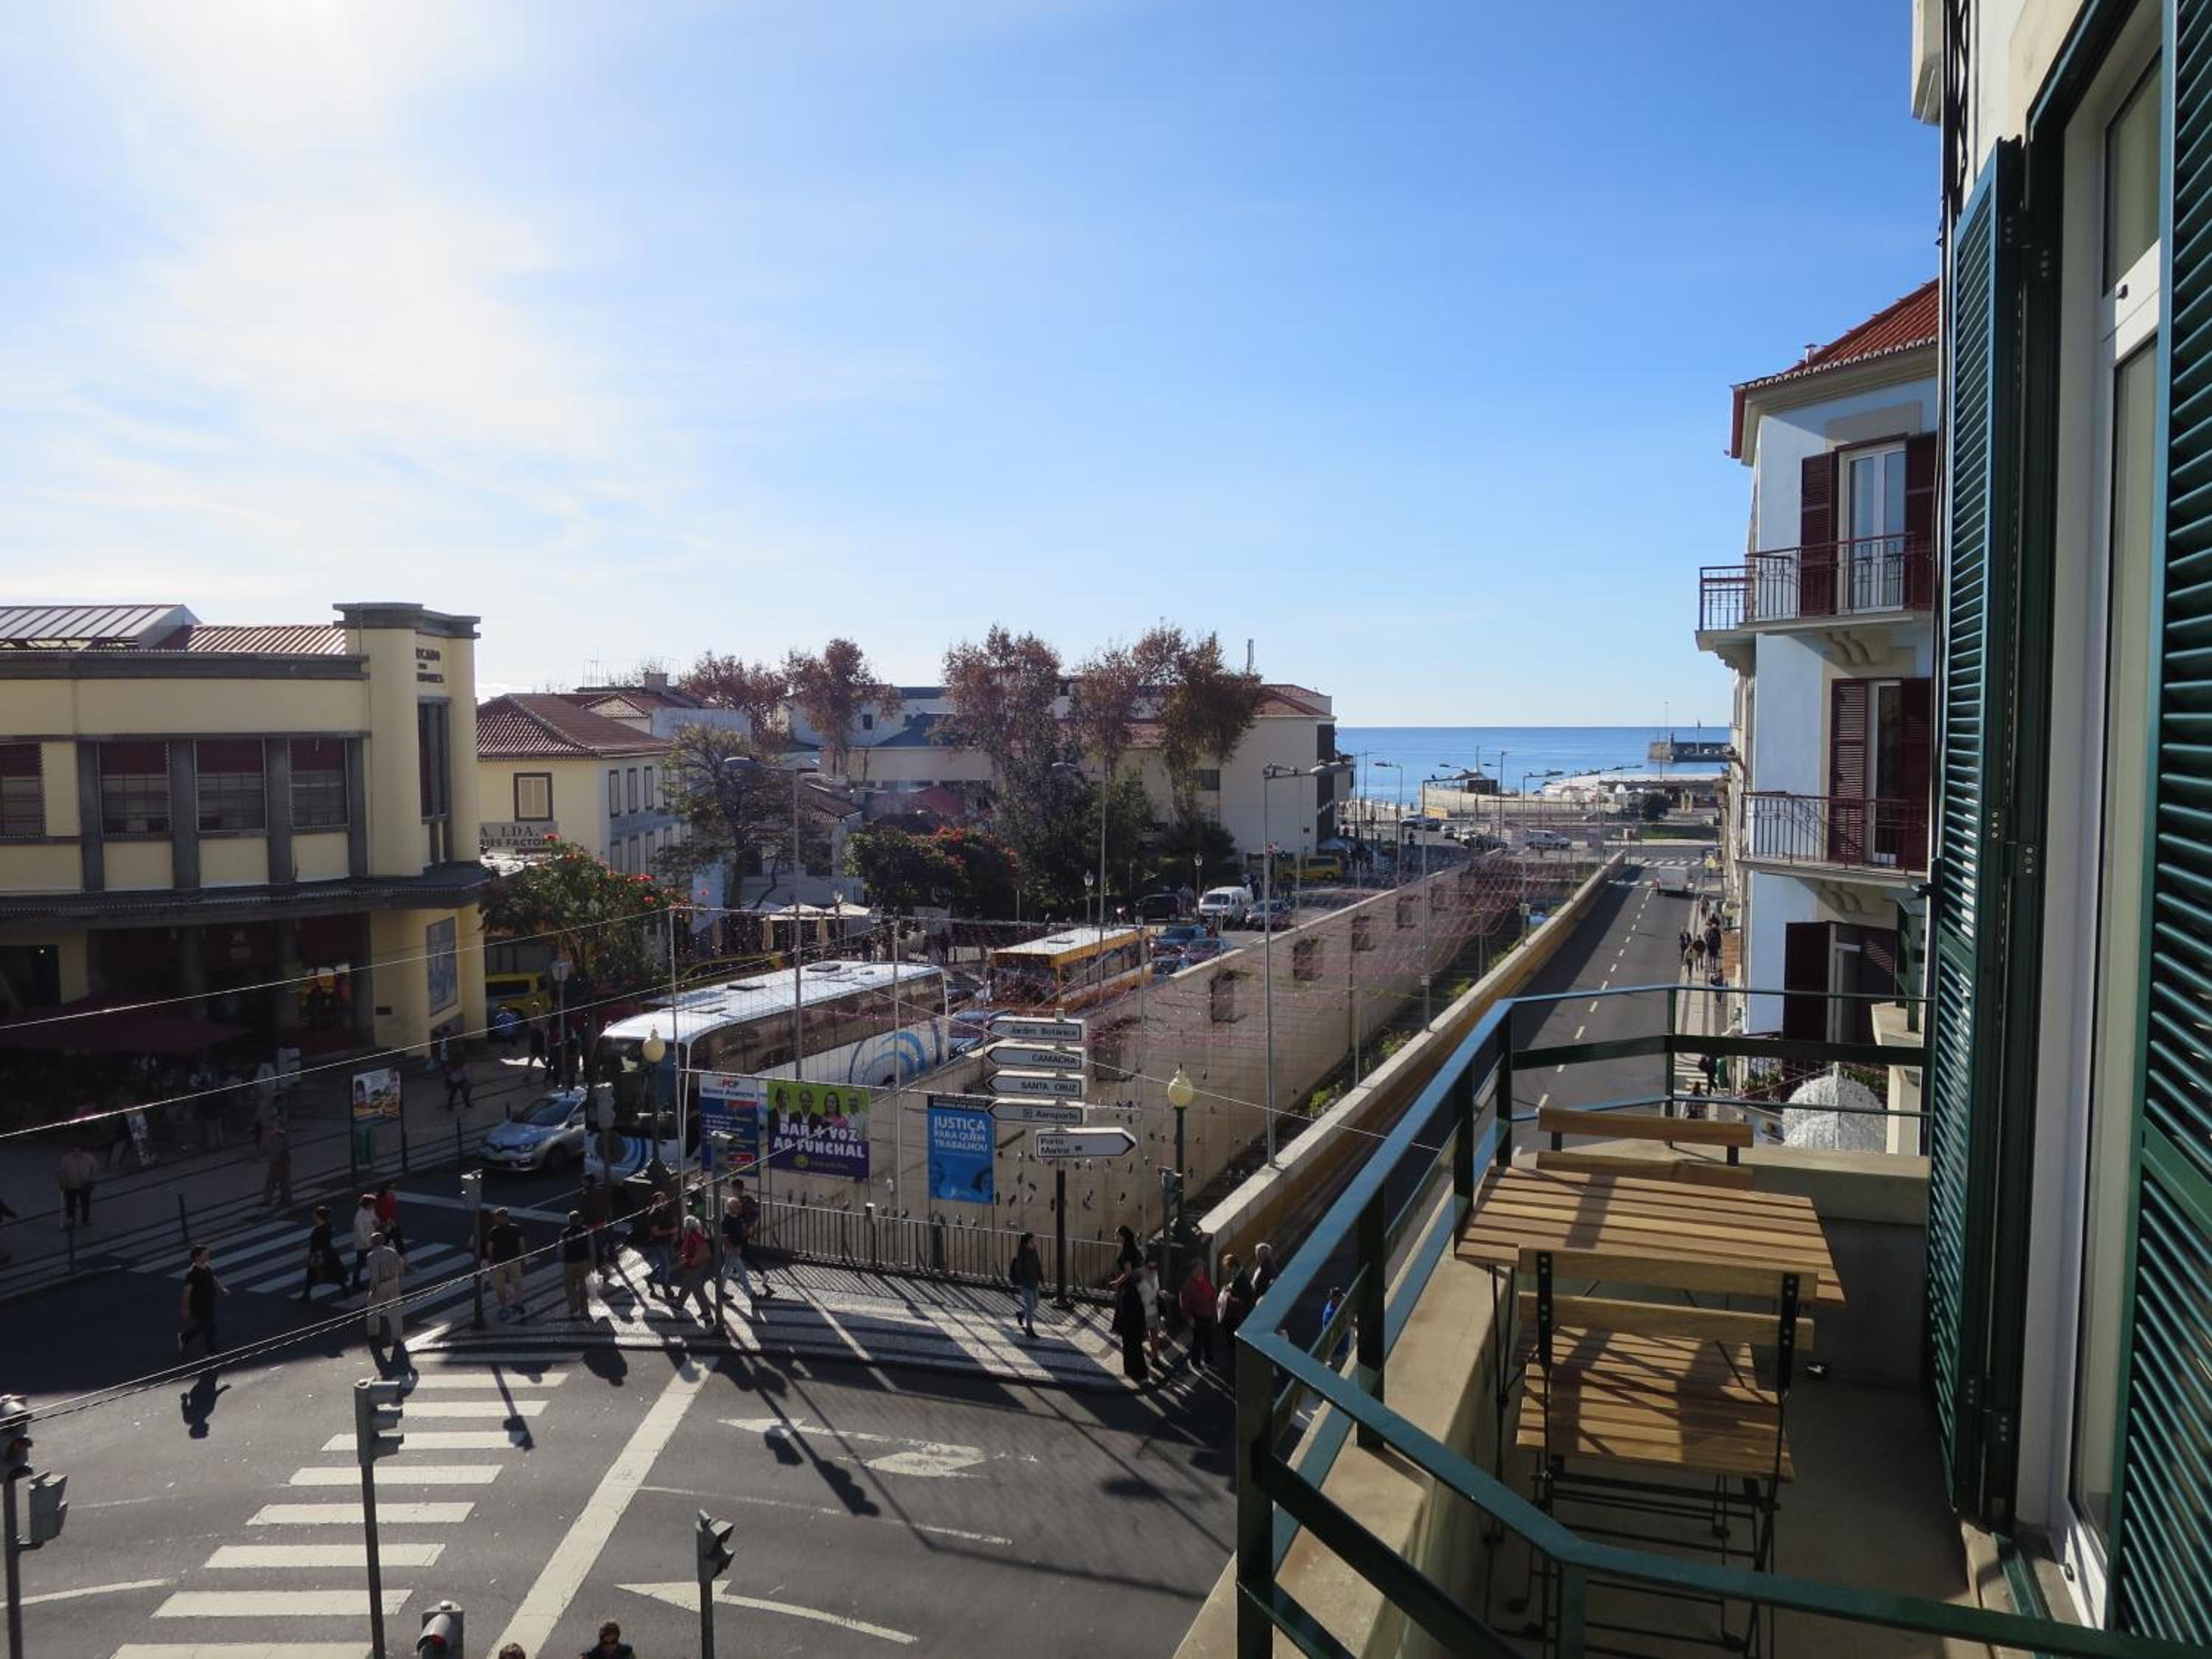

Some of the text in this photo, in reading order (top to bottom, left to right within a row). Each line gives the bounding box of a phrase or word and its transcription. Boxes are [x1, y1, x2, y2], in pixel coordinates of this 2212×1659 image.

[1032, 1054, 1076, 1064] CAMACHA
[1020, 1081, 1077, 1093] SANTA CRUZ
[779, 1121, 810, 1137] DAR
[829, 1127, 858, 1142] VOZ
[934, 1116, 985, 1132] JUSTIÇA
[773, 1136, 865, 1158] AO FUNCHAL
